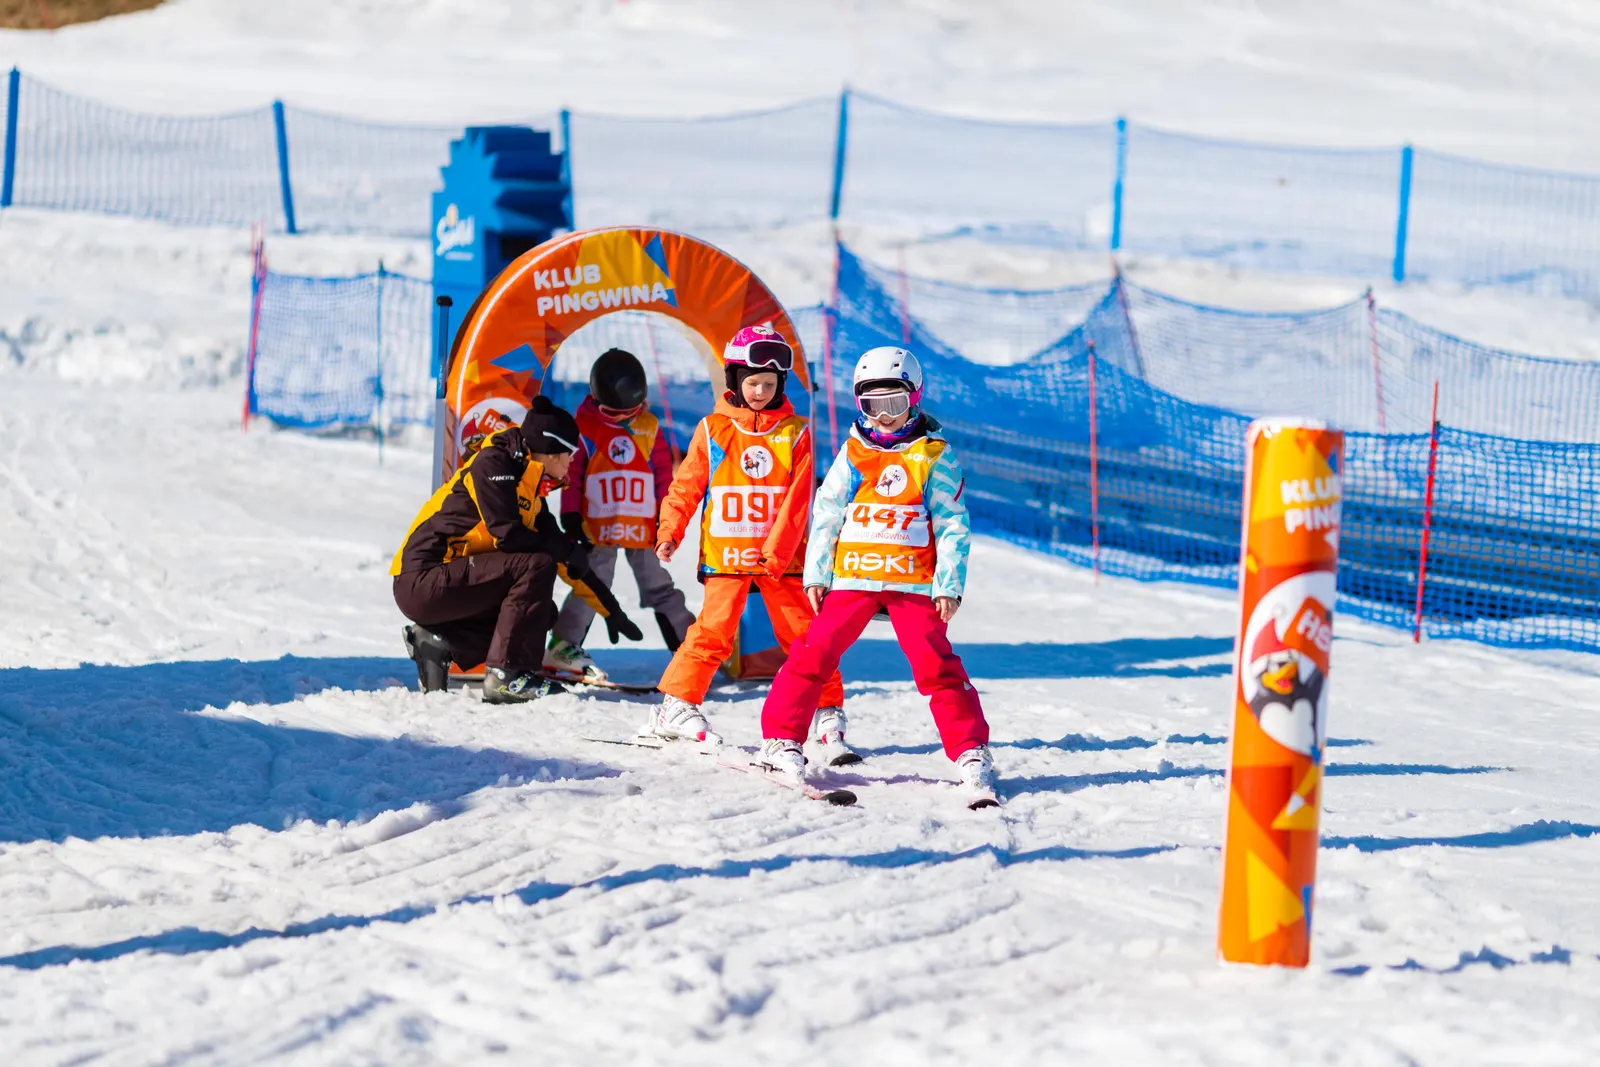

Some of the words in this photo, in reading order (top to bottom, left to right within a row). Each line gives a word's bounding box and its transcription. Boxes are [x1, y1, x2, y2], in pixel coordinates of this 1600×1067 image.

[533, 264, 601, 291] KLUB
[537, 282, 668, 317] PINGWINA
[484, 414, 508, 432] HS
[599, 476, 645, 504] 100
[853, 505, 920, 530] 447
[871, 532, 911, 541] PINGWINA
[722, 546, 760, 567] HS
